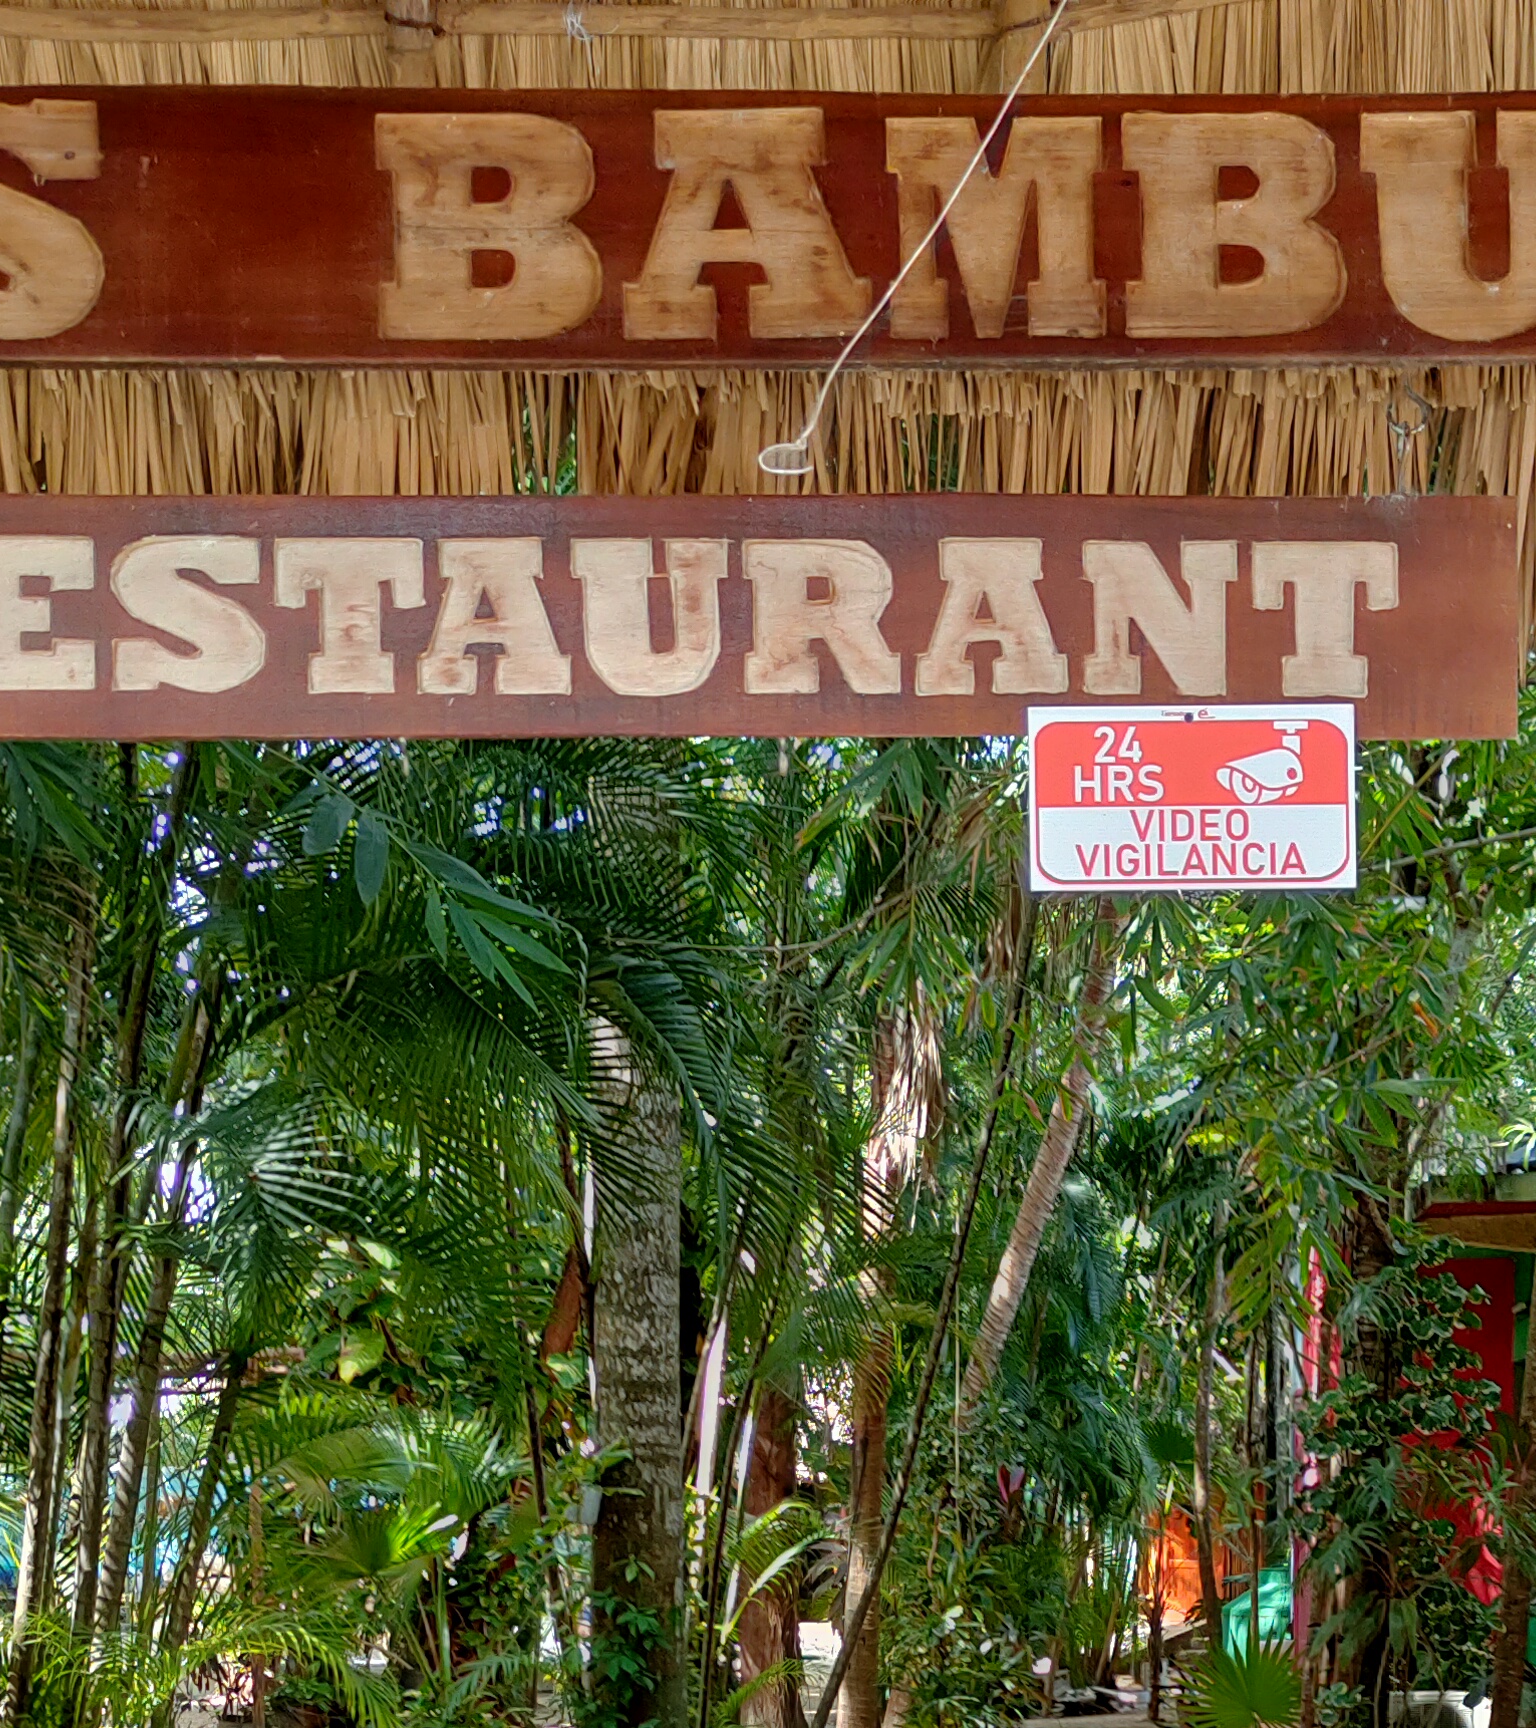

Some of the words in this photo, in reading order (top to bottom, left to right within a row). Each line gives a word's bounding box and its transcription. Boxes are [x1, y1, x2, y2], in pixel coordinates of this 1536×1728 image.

[1092, 725, 1144, 765] 24
[1073, 765, 1165, 803] HRS
[1128, 808, 1251, 842] VIDEO
[1075, 842, 1307, 878] VIGILANCIA
